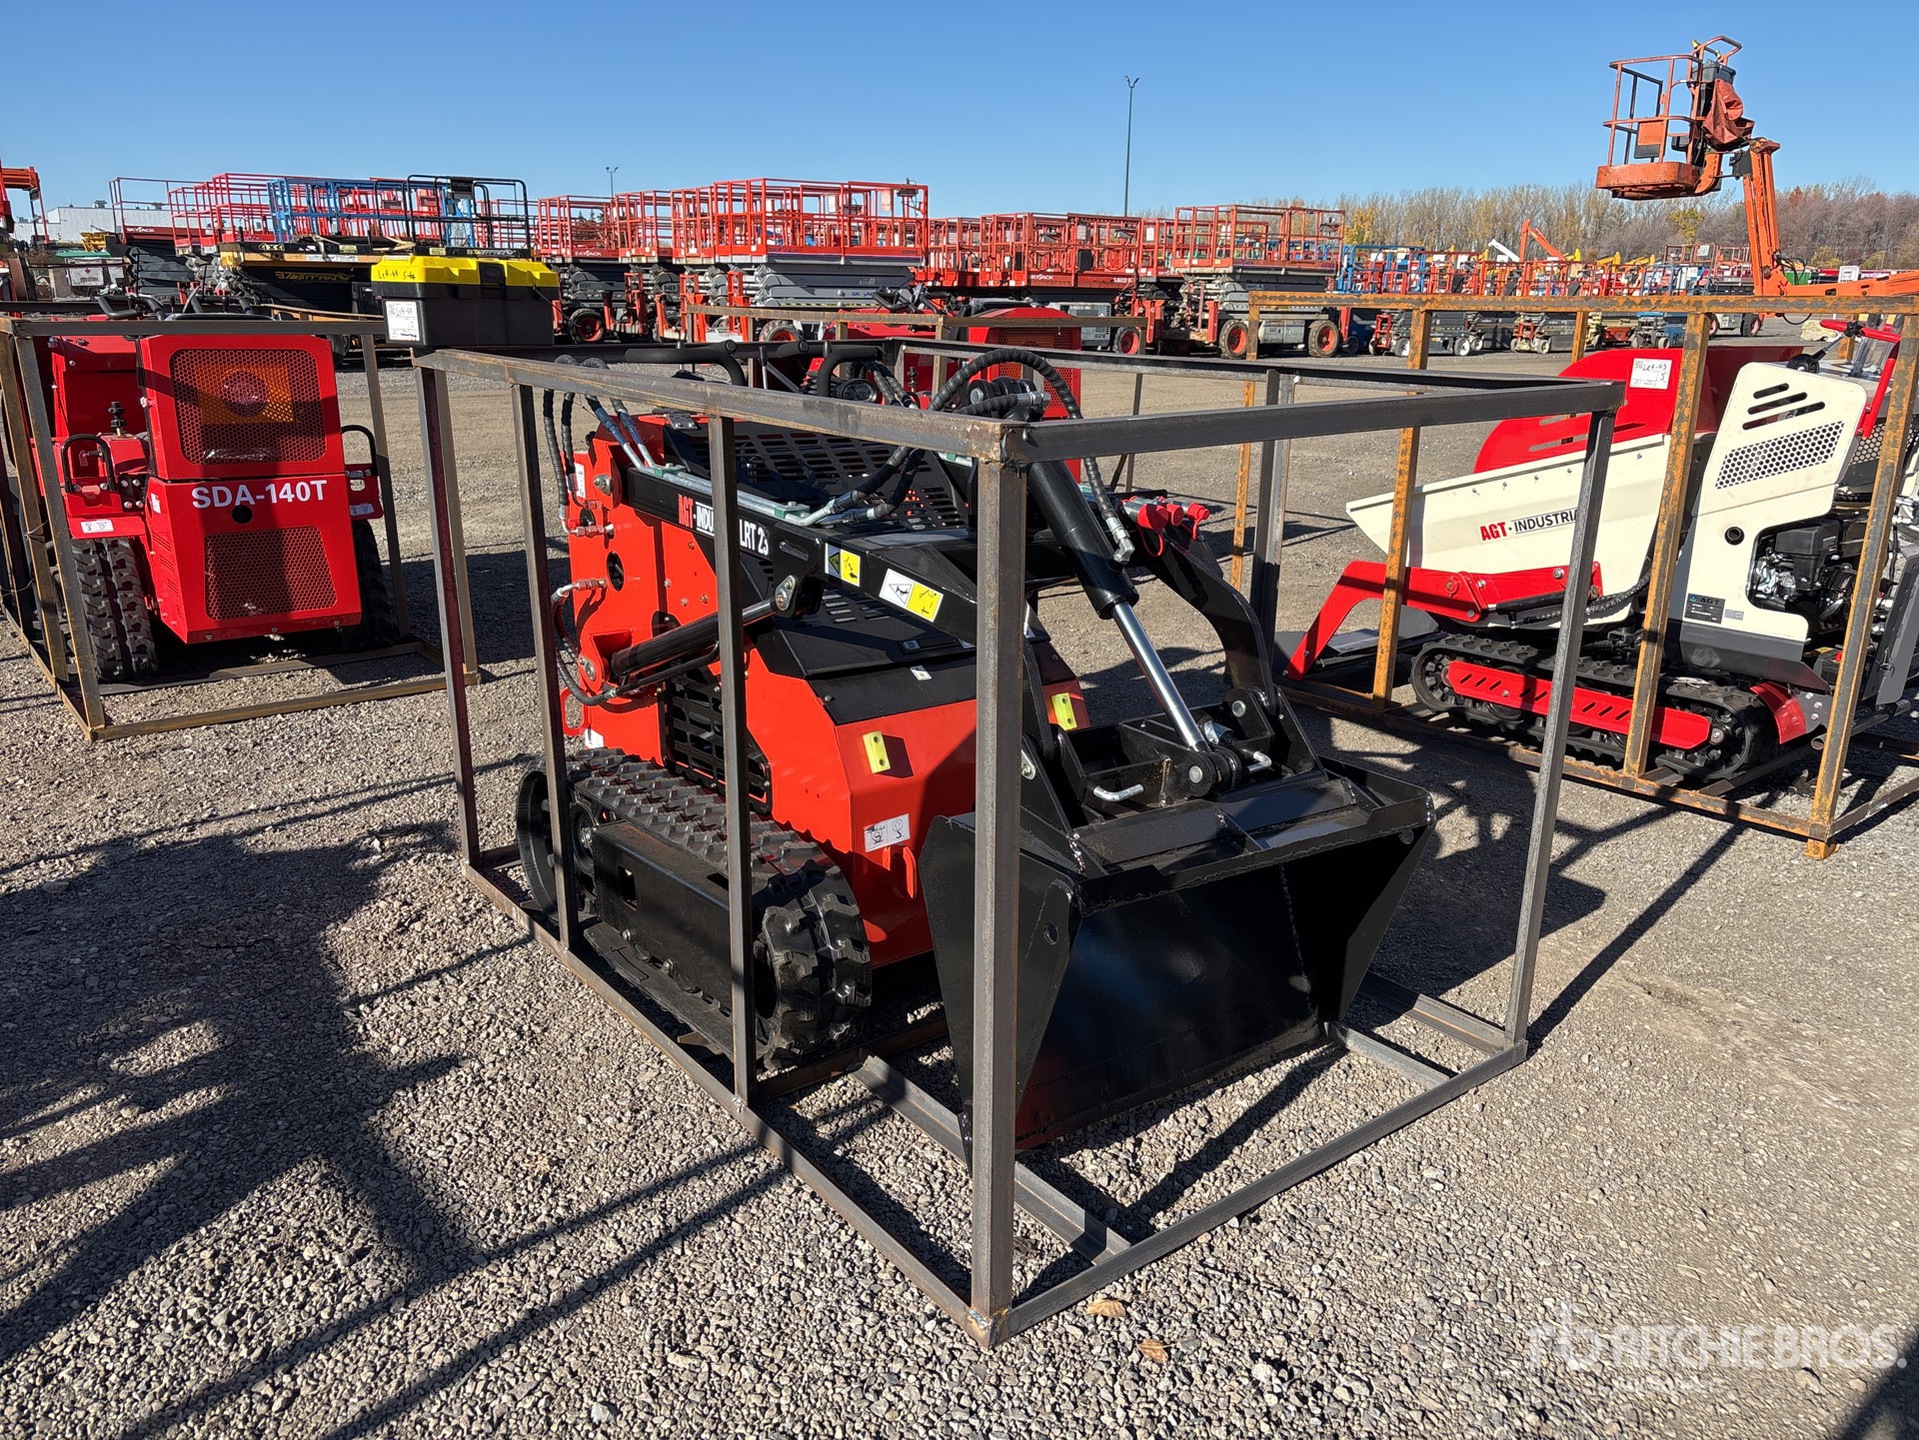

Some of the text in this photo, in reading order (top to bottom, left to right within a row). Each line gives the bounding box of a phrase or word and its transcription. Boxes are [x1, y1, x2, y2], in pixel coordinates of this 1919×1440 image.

[191, 480, 328, 508] SDA-140T
[678, 494, 693, 528] AGT
[739, 519, 757, 551] LRT
[1480, 521, 1508, 541] AGT
